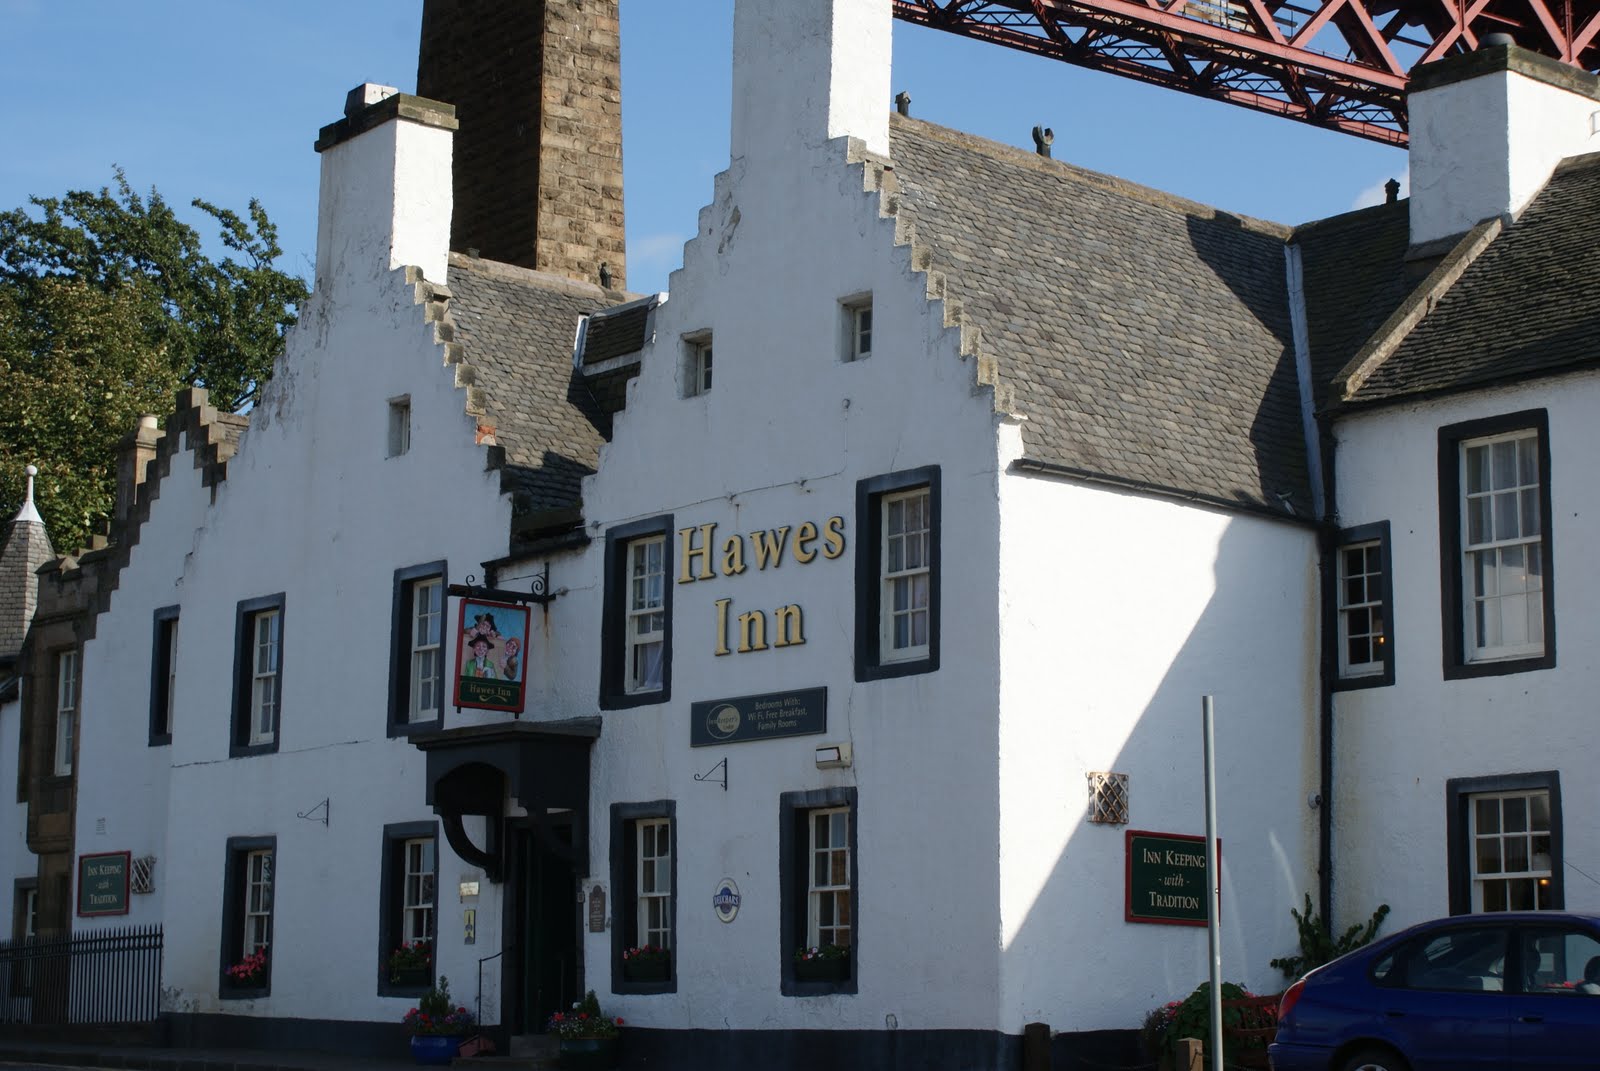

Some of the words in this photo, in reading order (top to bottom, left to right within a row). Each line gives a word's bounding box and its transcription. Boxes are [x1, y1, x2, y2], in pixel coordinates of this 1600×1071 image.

[678, 515, 846, 584] Hawes
[714, 598, 806, 656] Inn
[470, 684, 495, 694] Hawes
[497, 687, 511, 697] Inn
[755, 701, 783, 710] Bedrooms
[783, 697, 801, 706] With:
[766, 710, 778, 719] Free
[779, 706, 808, 718] Breakfast,
[758, 720, 777, 731] Family
[777, 719, 797, 728] Rooms
[1143, 848, 1161, 864] INN
[1165, 850, 1206, 868] KEEPING
[87, 866, 98, 877] INN
[99, 864, 122, 875] KEEPING
[1164, 874, 1184, 887] with
[90, 894, 118, 905] TRADITION
[1149, 891, 1199, 909] TRADITION
